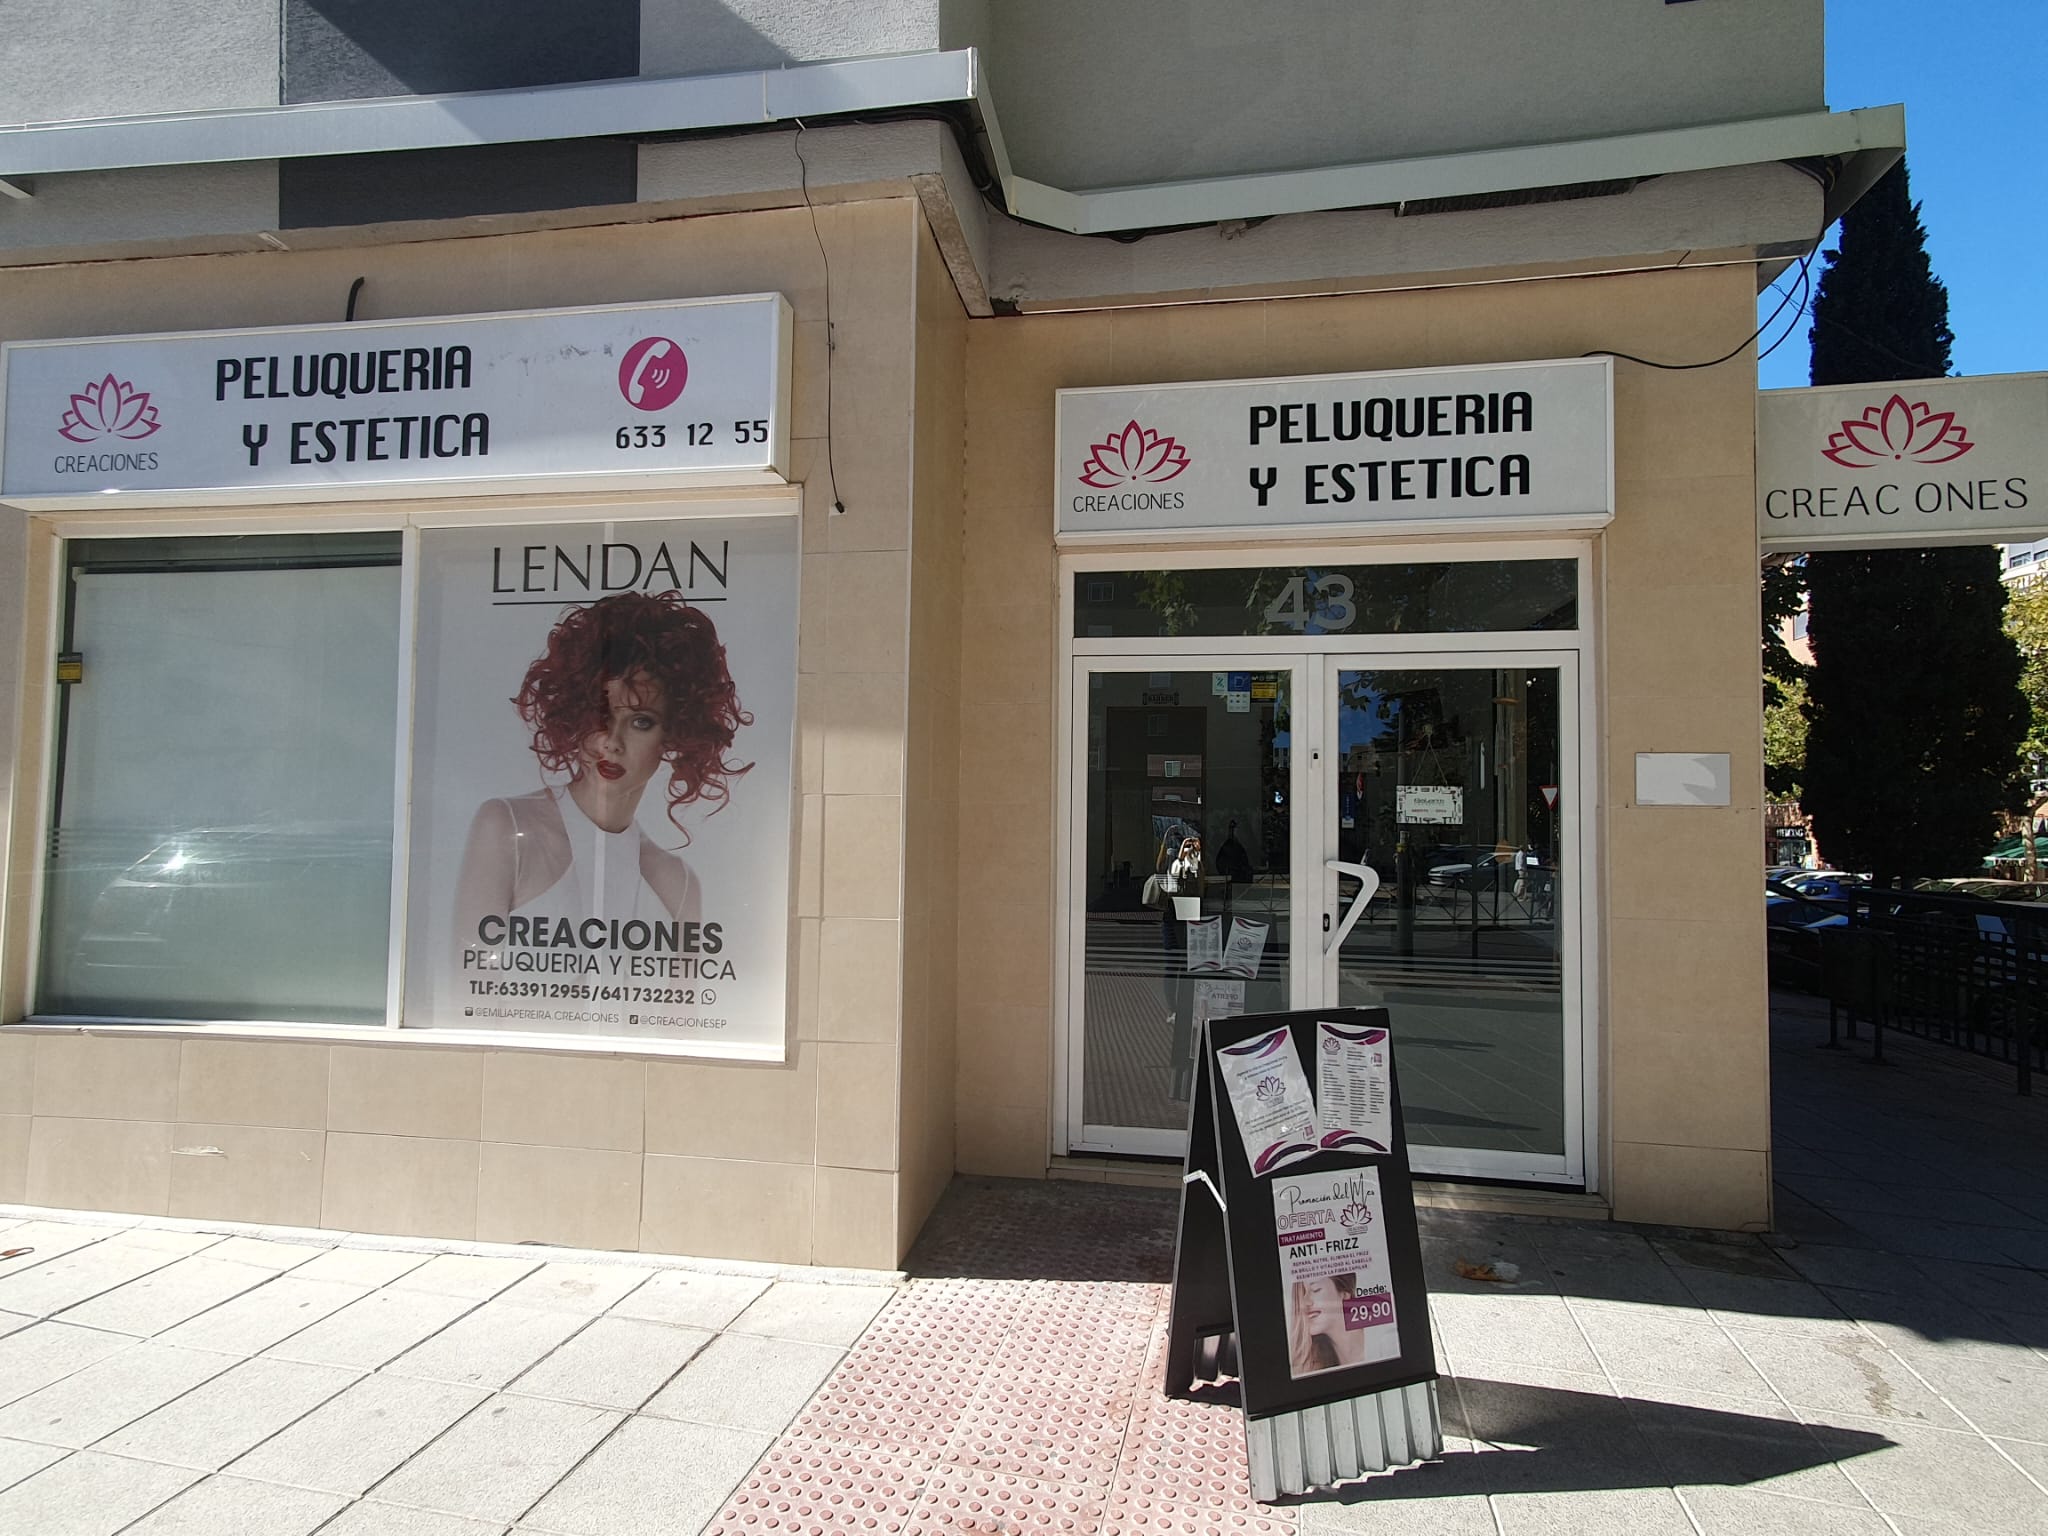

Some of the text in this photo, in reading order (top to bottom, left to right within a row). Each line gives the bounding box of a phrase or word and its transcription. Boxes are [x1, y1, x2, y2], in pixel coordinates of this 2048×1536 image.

[216, 345, 471, 401] PELUQUERIA
[1248, 391, 1533, 445] PELUQUERIA
[242, 412, 490, 466] Y ESTETICA
[615, 420, 769, 449] 633 12 55
[54, 452, 159, 474] CREACIONES
[1249, 453, 1531, 507] Y ESTETICA
[1072, 492, 1185, 513] CREACIONES
[493, 540, 729, 593] LENDAN
[1265, 574, 1356, 631] 43
[478, 914, 723, 954] CREACIONES
[463, 949, 737, 981] PELUQUERIA Y ESTETICA
[470, 980, 695, 1005] TLF:633912955/641732232
[640, 1016, 727, 1029] @CREACIONESEP
[1278, 1209, 1335, 1230] OFERTA
[1281, 1231, 1323, 1243] TRATAMIENTO
[1290, 1243, 1317, 1259] ANTI
[1326, 1237, 1359, 1253] FRIZZ
[1356, 1284, 1386, 1297] Desde:
[1350, 1301, 1391, 1322] 29,90
